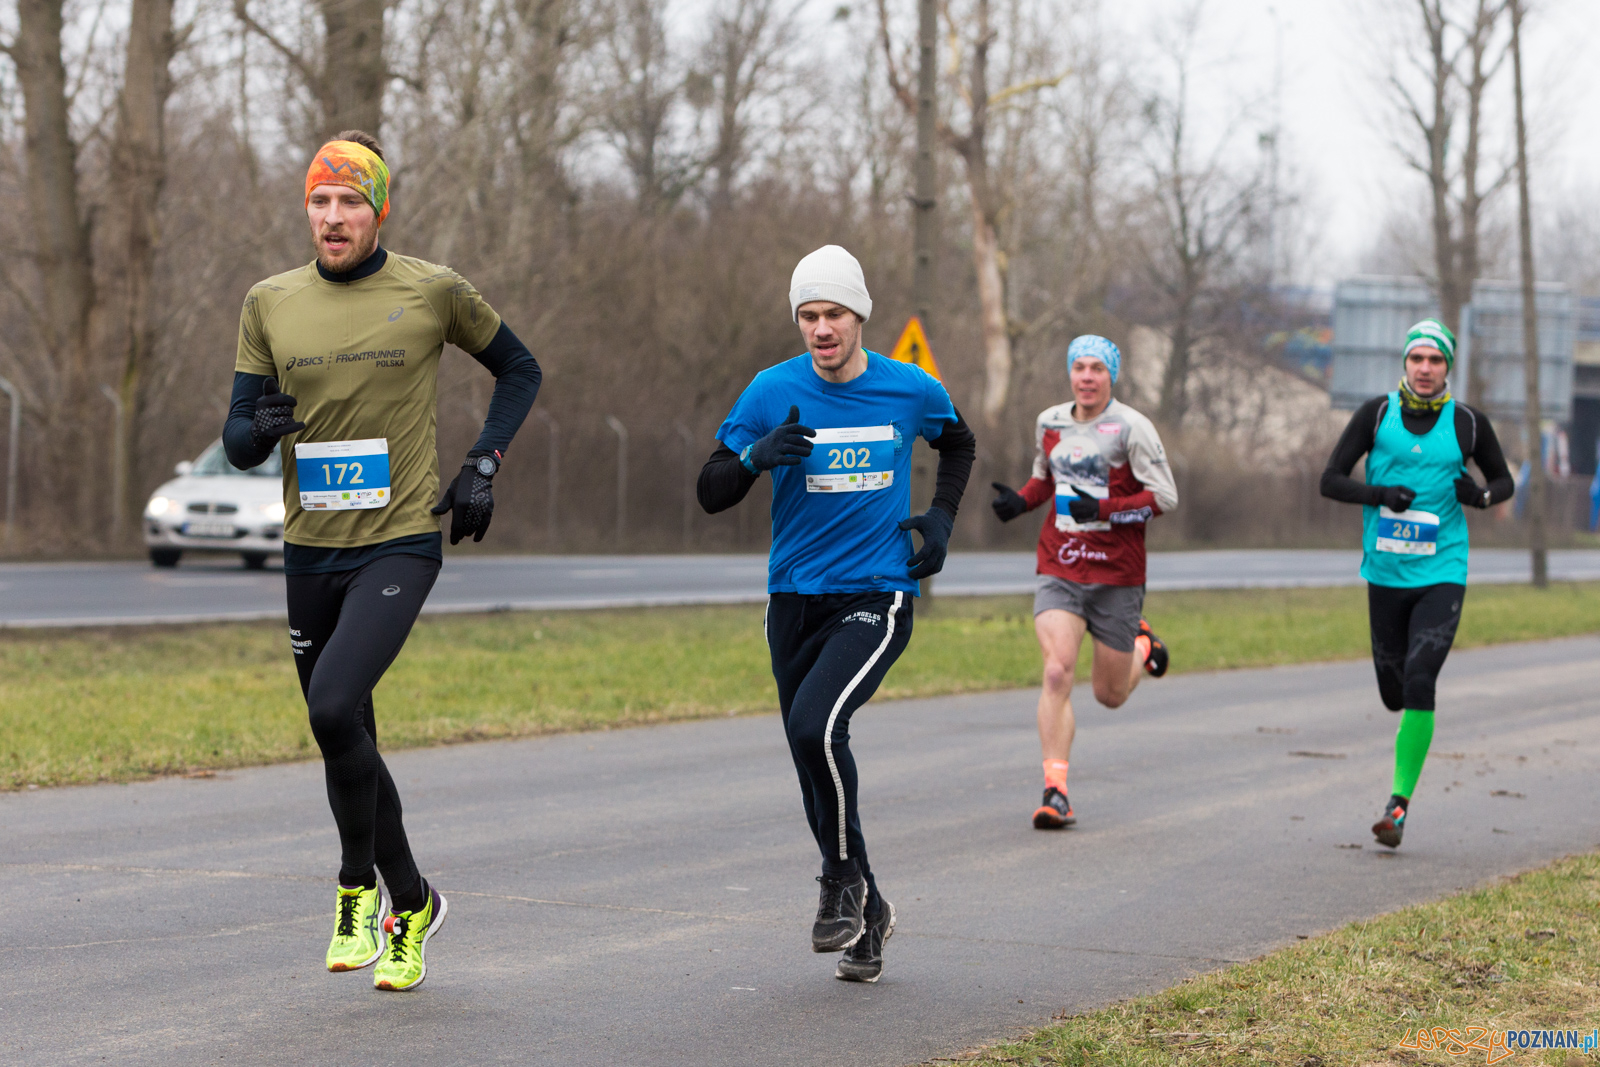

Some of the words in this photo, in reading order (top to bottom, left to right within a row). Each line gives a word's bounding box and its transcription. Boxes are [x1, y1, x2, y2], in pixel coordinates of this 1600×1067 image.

[336, 350, 405, 363] FRONTRUNNER
[376, 359, 404, 368] POLSKA
[828, 447, 871, 469] 202
[322, 462, 364, 485] 172
[1392, 522, 1420, 539] 261
[853, 611, 881, 621] ANGELES
